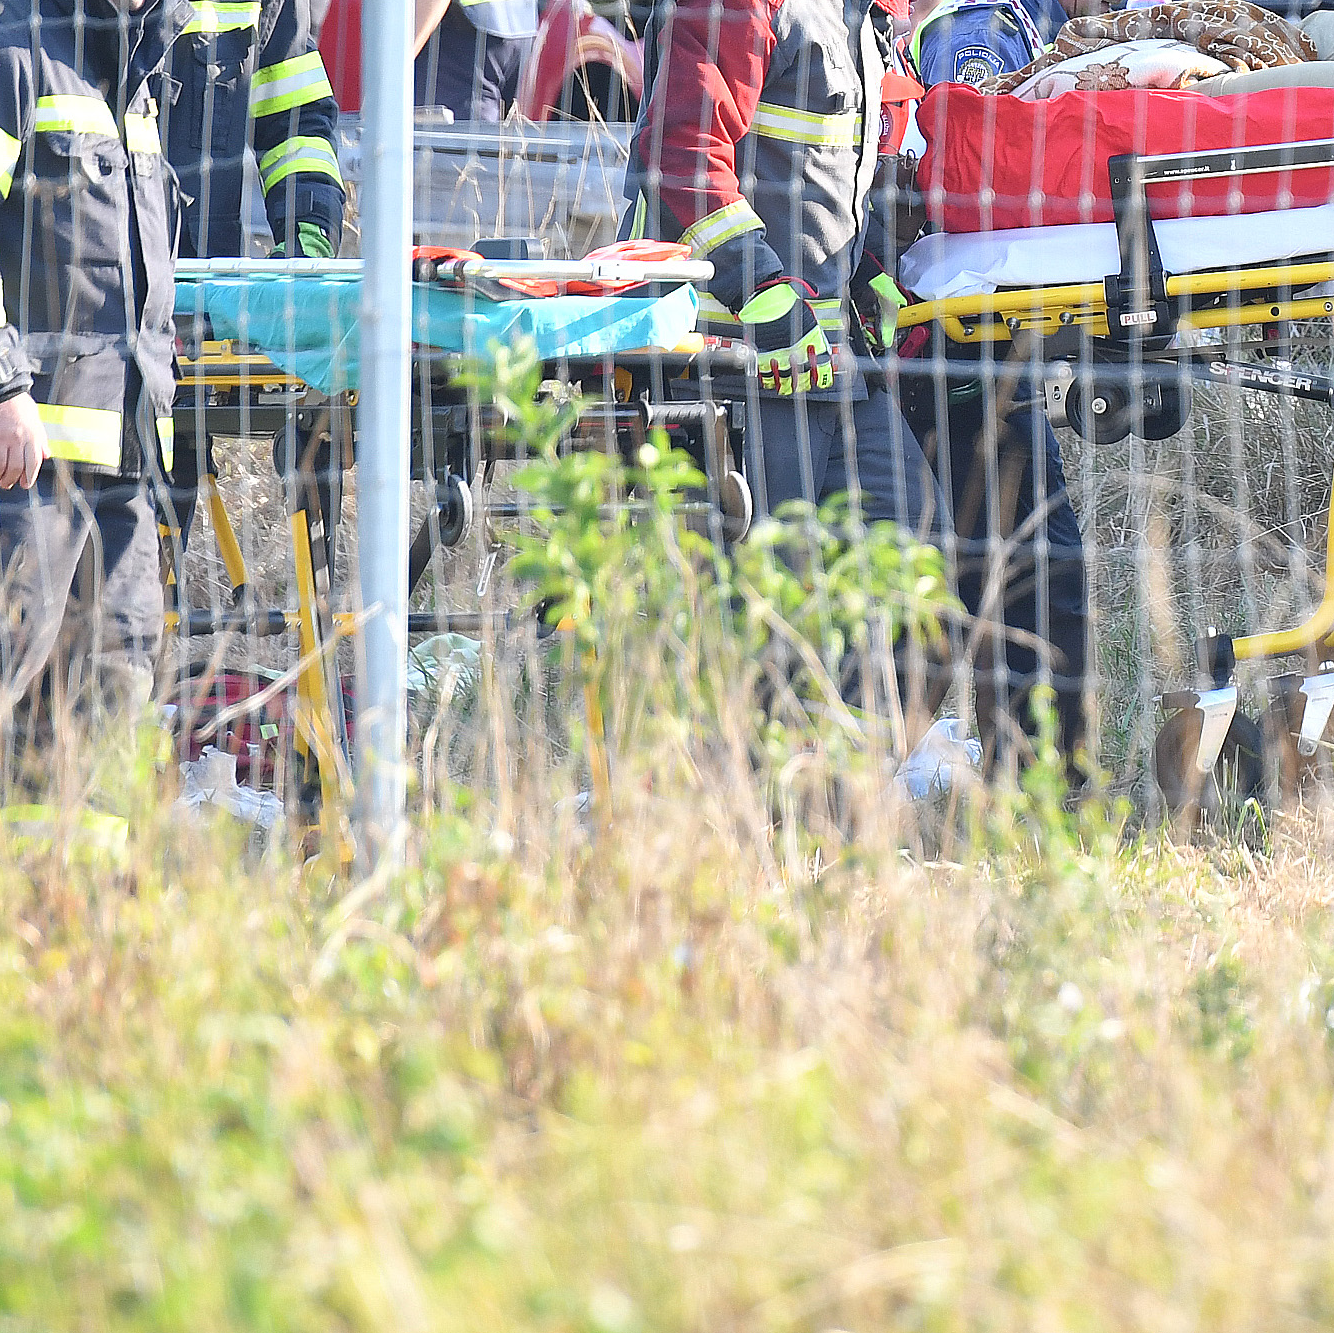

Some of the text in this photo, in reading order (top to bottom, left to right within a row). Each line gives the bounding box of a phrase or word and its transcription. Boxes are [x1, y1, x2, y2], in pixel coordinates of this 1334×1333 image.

[957, 49, 1001, 69] POLICIJA
[1124, 312, 1155, 325] PULL
[1208, 361, 1314, 392] SPENCER
